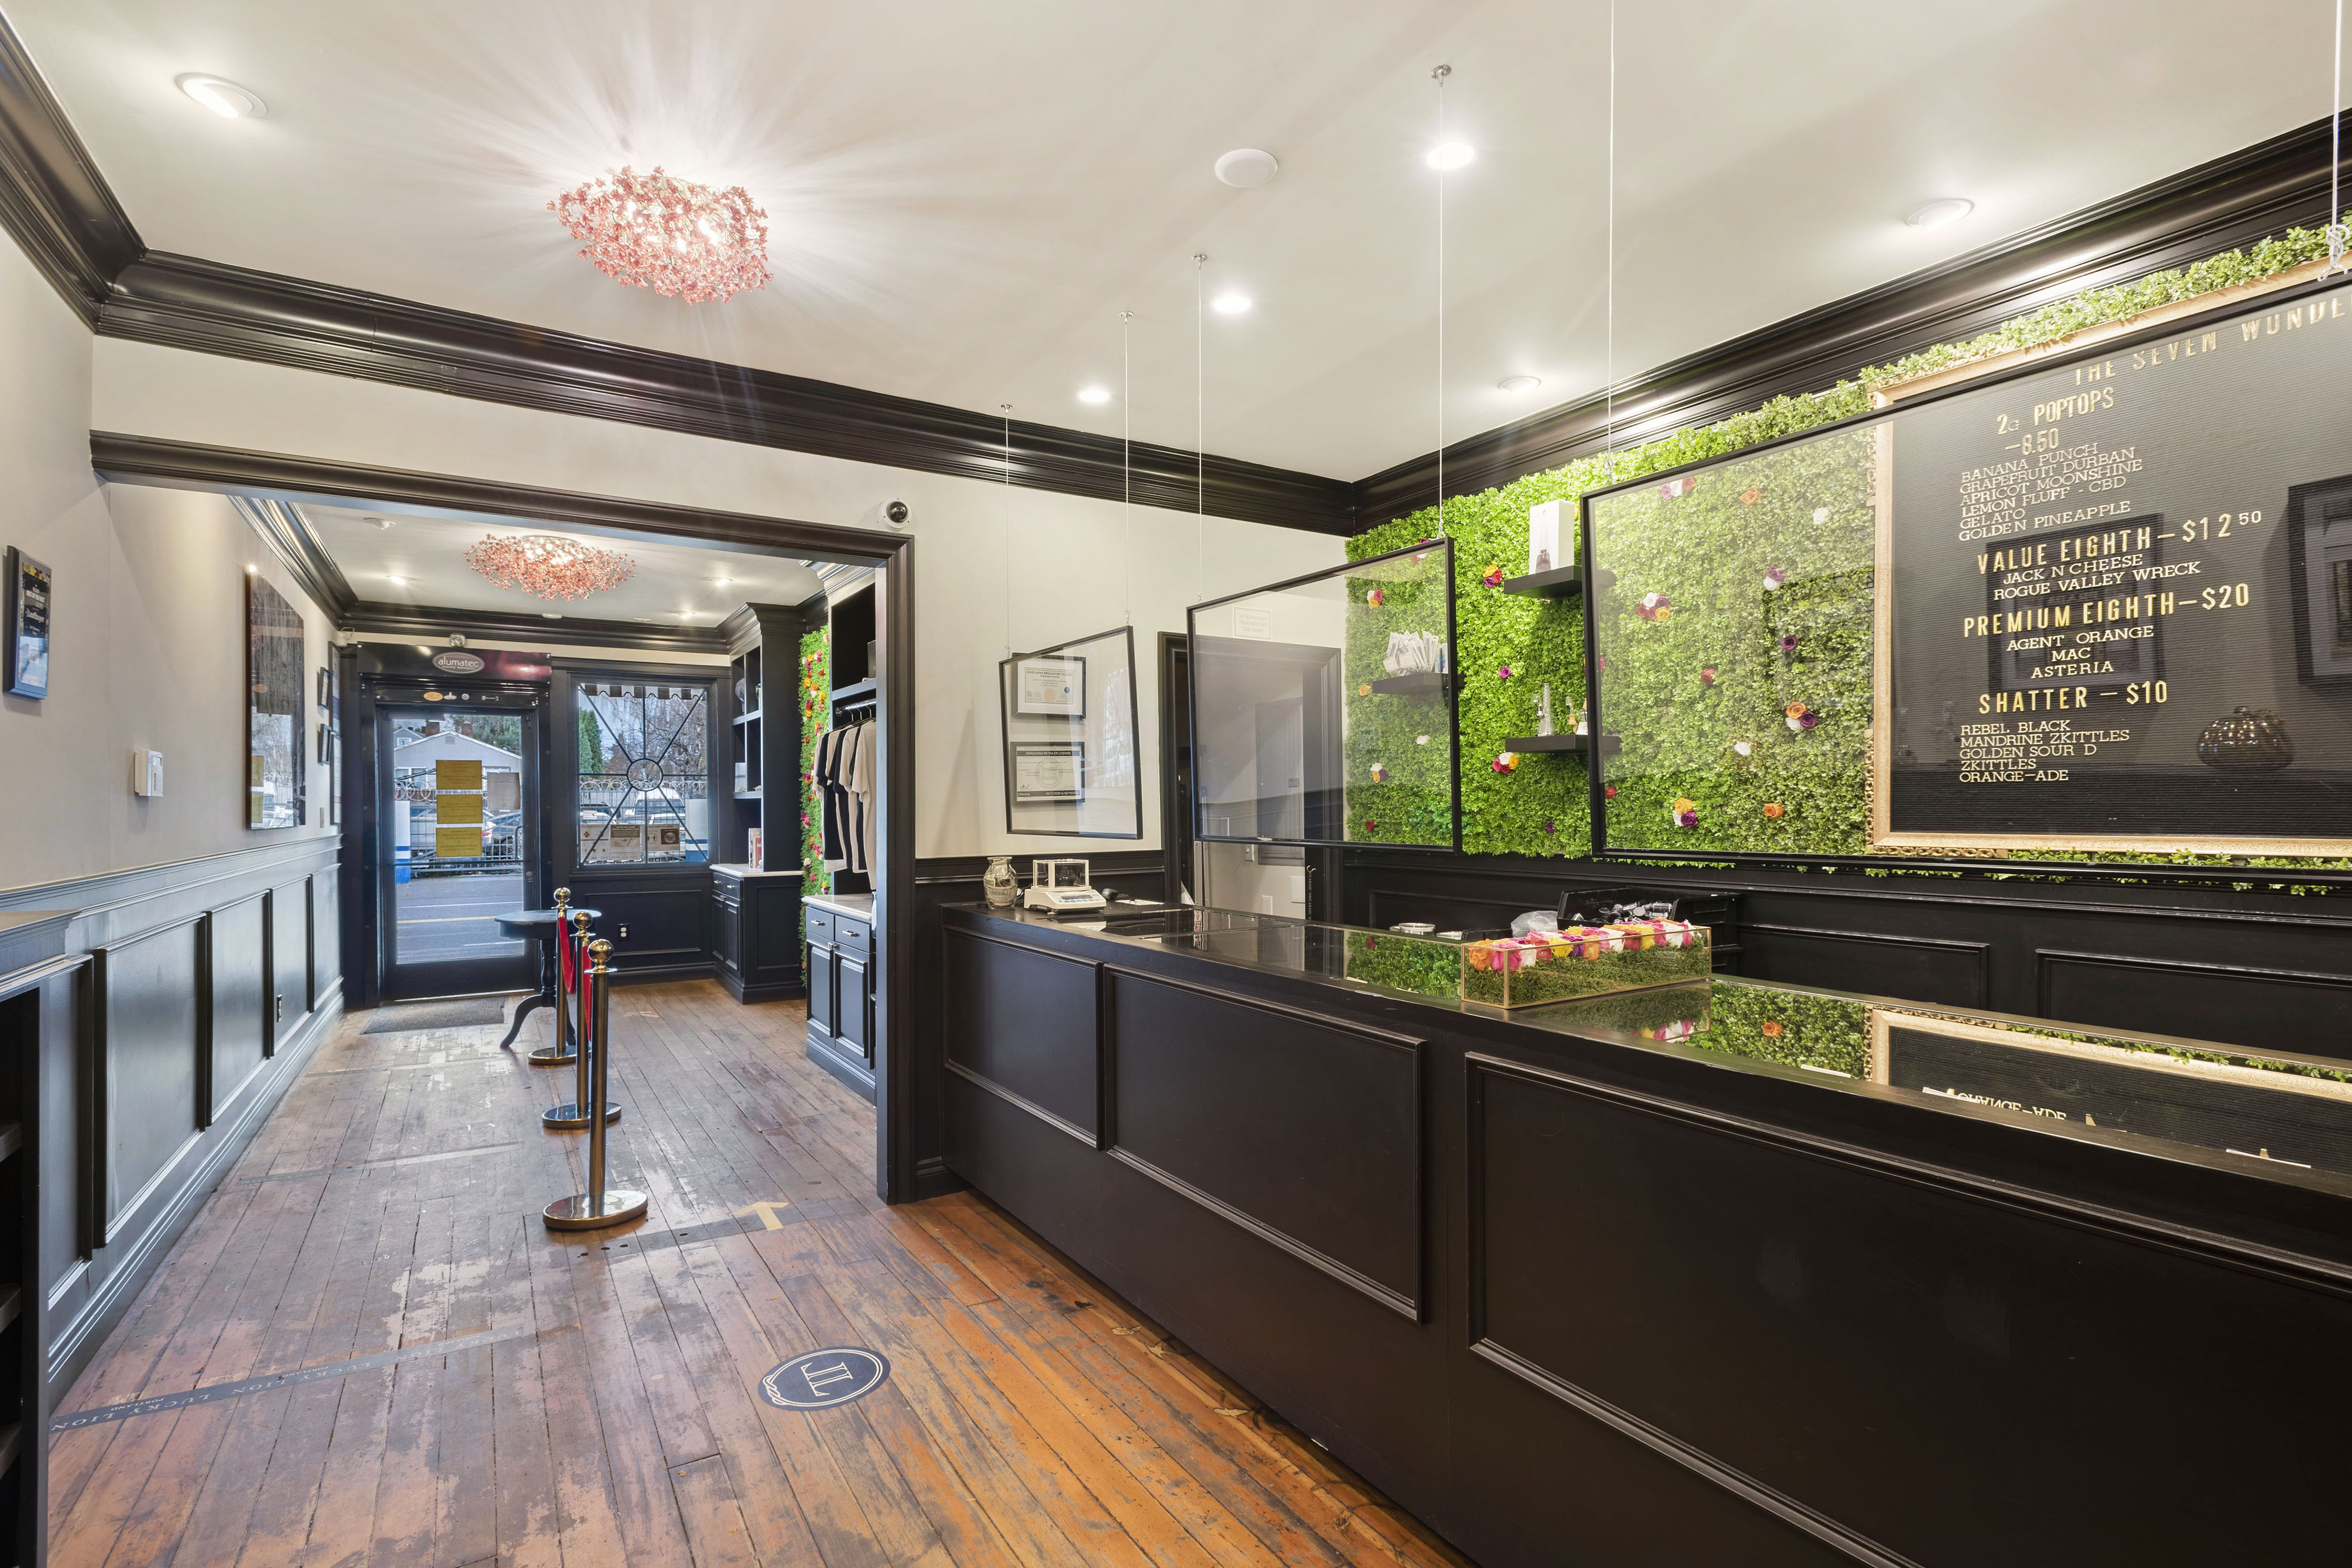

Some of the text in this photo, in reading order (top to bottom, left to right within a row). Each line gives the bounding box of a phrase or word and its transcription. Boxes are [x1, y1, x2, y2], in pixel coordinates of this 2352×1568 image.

[2075, 293, 2352, 386] THE SEVEN WUNDE
[2033, 387, 2115, 426] POPTOPS
[1959, 447, 2136, 494] GRAPEFRUIT DURBAN
[1961, 443, 2098, 483] BANANA PUNCH
[1959, 459, 2143, 507] APRICOT MOONSHINE
[1961, 497, 2016, 518] LEMON
[2022, 487, 2070, 507] FLUFF
[2089, 476, 2127, 493] CBD
[1959, 500, 2131, 542] GOLDEN PINEAPPLE
[1960, 508, 2025, 530] GELATO
[1977, 543, 2047, 574] VALUE
[2003, 554, 2143, 584] JACK N CHEESE
[1994, 561, 2201, 600] ROGUE VALLEY WRECK
[1964, 605, 2071, 638] PREMIUM
[2006, 625, 2154, 651] AGENT ORANGE
[438, 655, 479, 668] alumatec
[2051, 647, 2091, 662] MAC
[2030, 661, 2114, 679] ASTERIA
[1978, 686, 2088, 714] SHATTER
[1960, 720, 2071, 736] REBEL BLACK
[1960, 729, 2130, 748] MANDRINE ZKITTLES
[1959, 744, 2097, 759] GOLDEN SOUR D
[1961, 758, 2037, 771] ZKITTLES
[231, 1362, 371, 1395] LUCKY LION
[51, 1394, 211, 1431] LUCKY LION
[111, 1397, 164, 1411] PORTLAND
